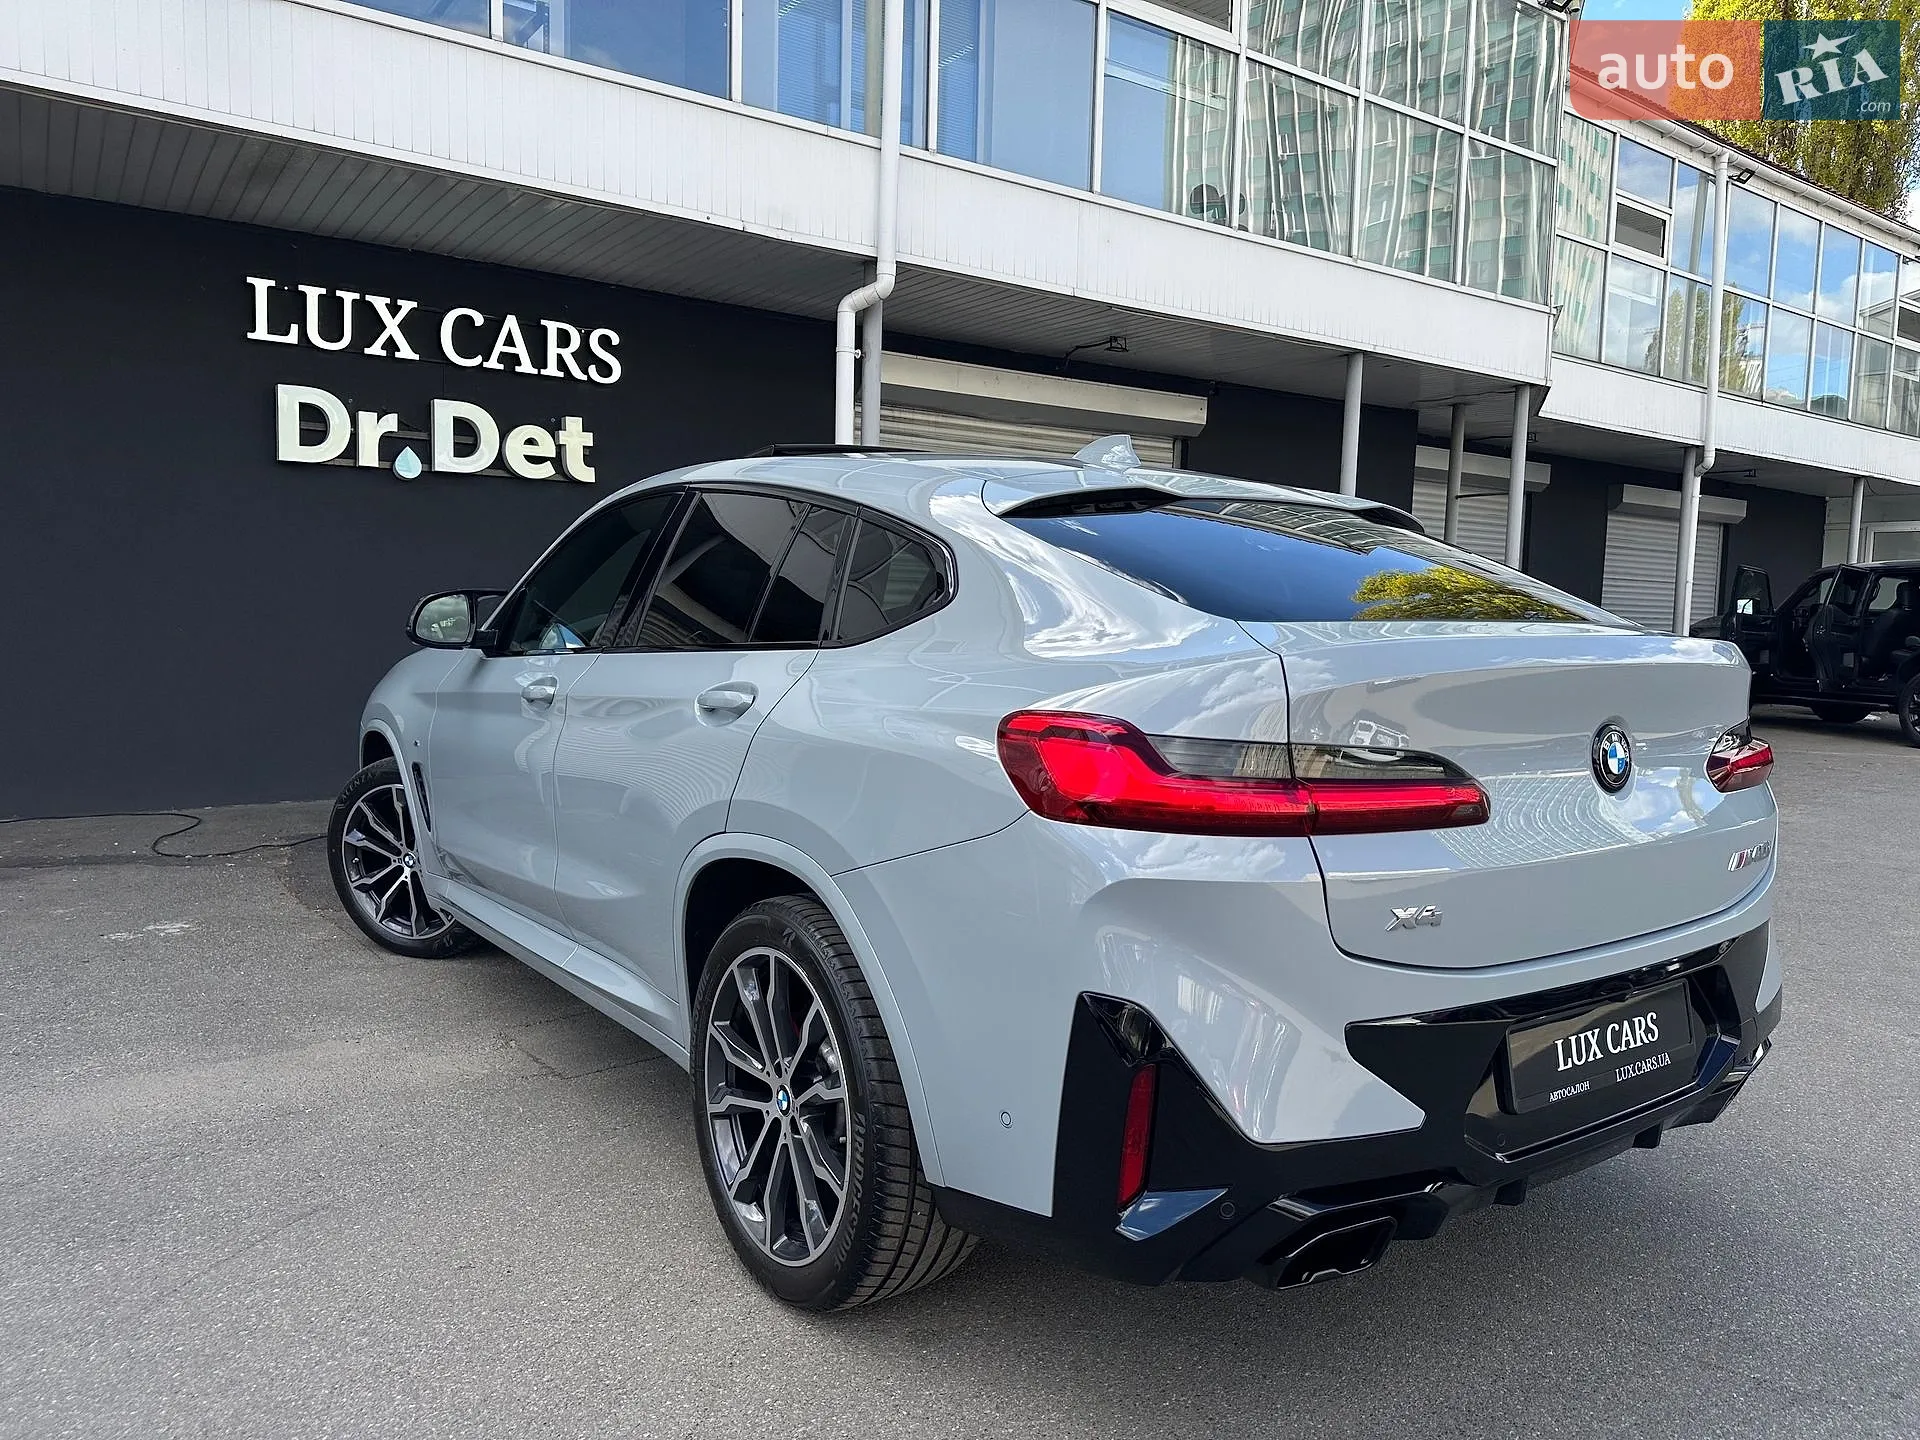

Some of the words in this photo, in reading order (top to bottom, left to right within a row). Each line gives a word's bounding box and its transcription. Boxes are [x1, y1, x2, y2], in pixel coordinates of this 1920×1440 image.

[246, 276, 420, 361] LUX
[440, 307, 622, 385] CARS
[1384, 904, 1442, 932] X4
[1554, 1027, 1604, 1072] LUX
[1606, 1011, 1660, 1054] CARS
[1549, 1080, 1590, 1103] АВТОСАЛОН
